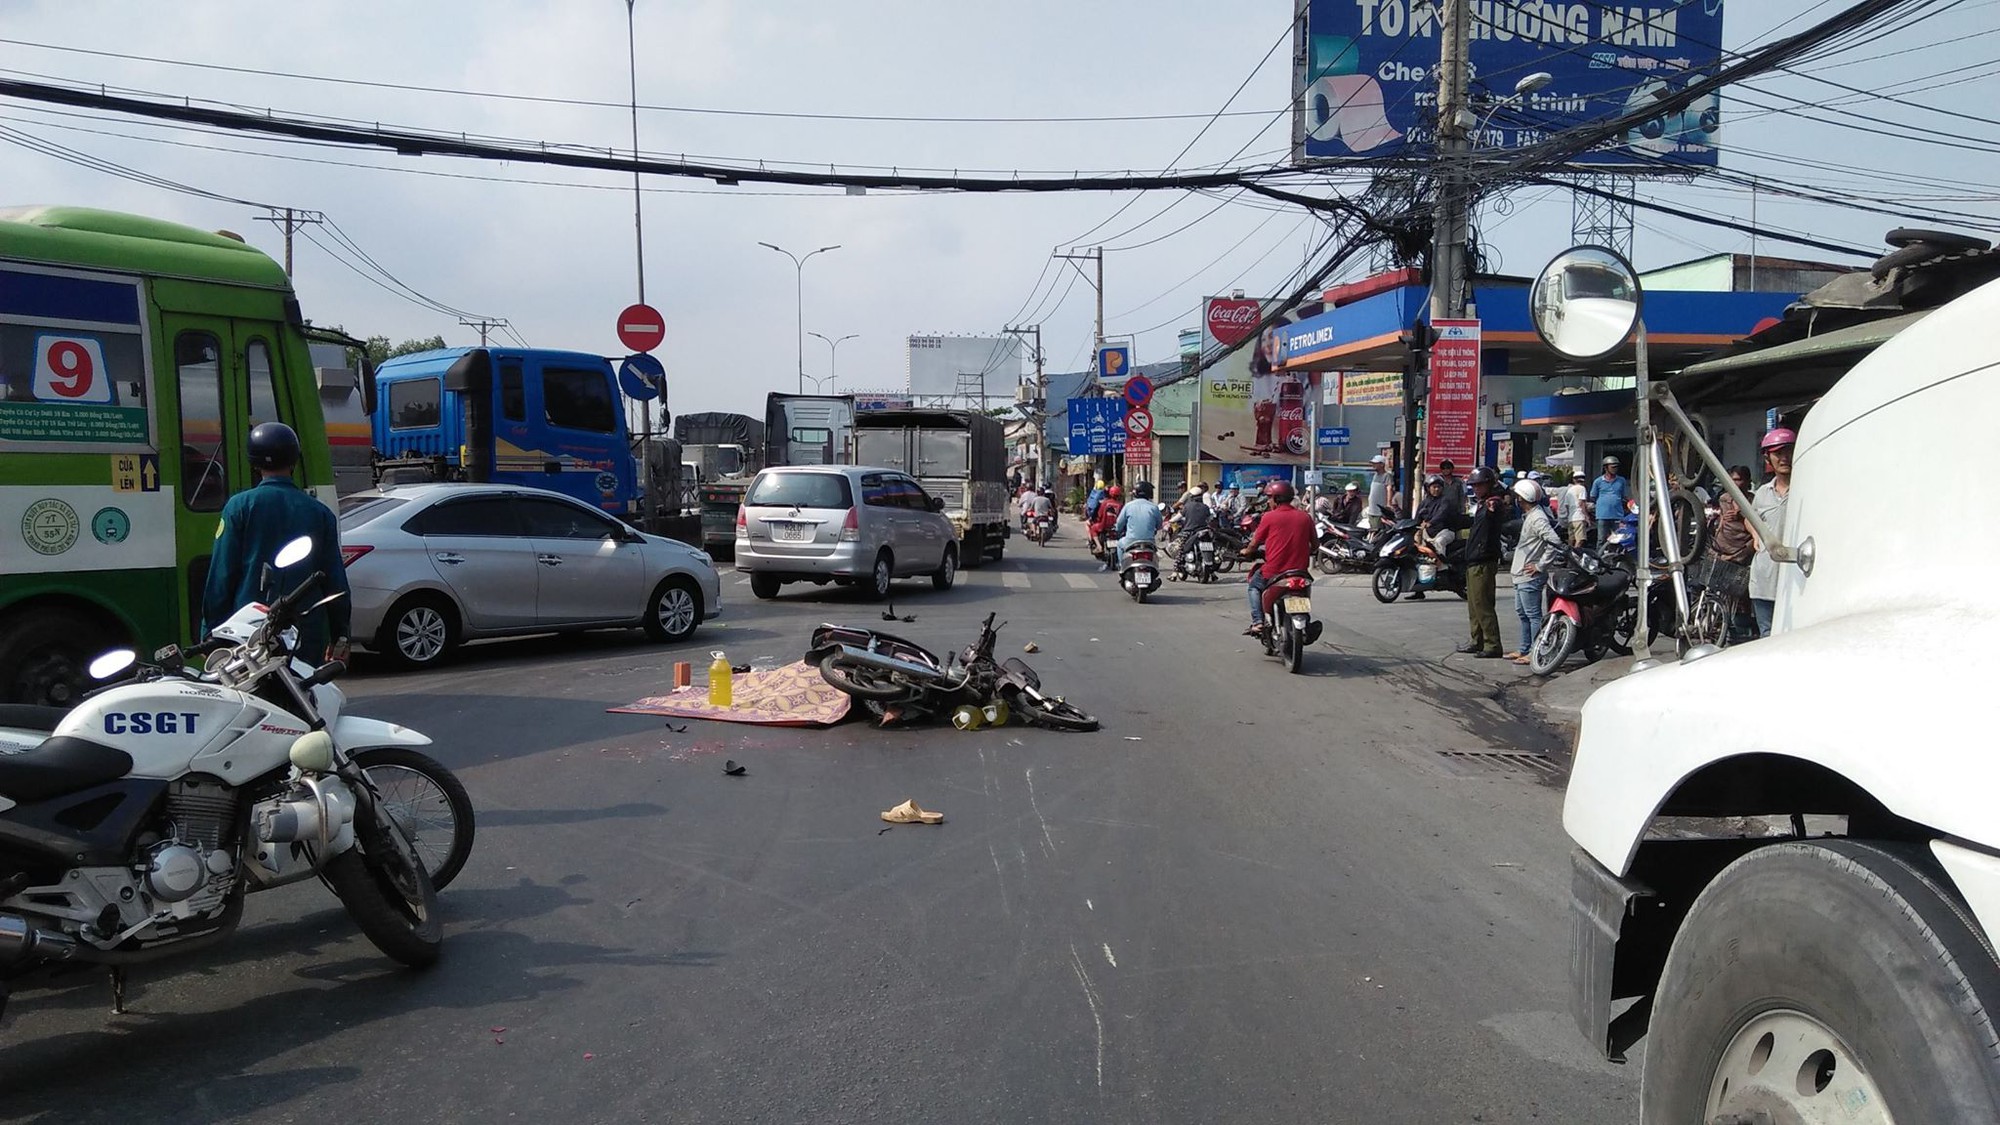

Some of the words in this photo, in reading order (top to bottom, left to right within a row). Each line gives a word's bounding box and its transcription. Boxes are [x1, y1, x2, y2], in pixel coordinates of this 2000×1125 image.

[1600, 5, 1677, 47] NAM
[1378, 61, 1425, 81] Che
[1290, 326, 1333, 351] PETROLIMEX
[47, 340, 94, 398] 9
[179, 690, 223, 698] HONDA
[104, 712, 200, 734] CSGT
